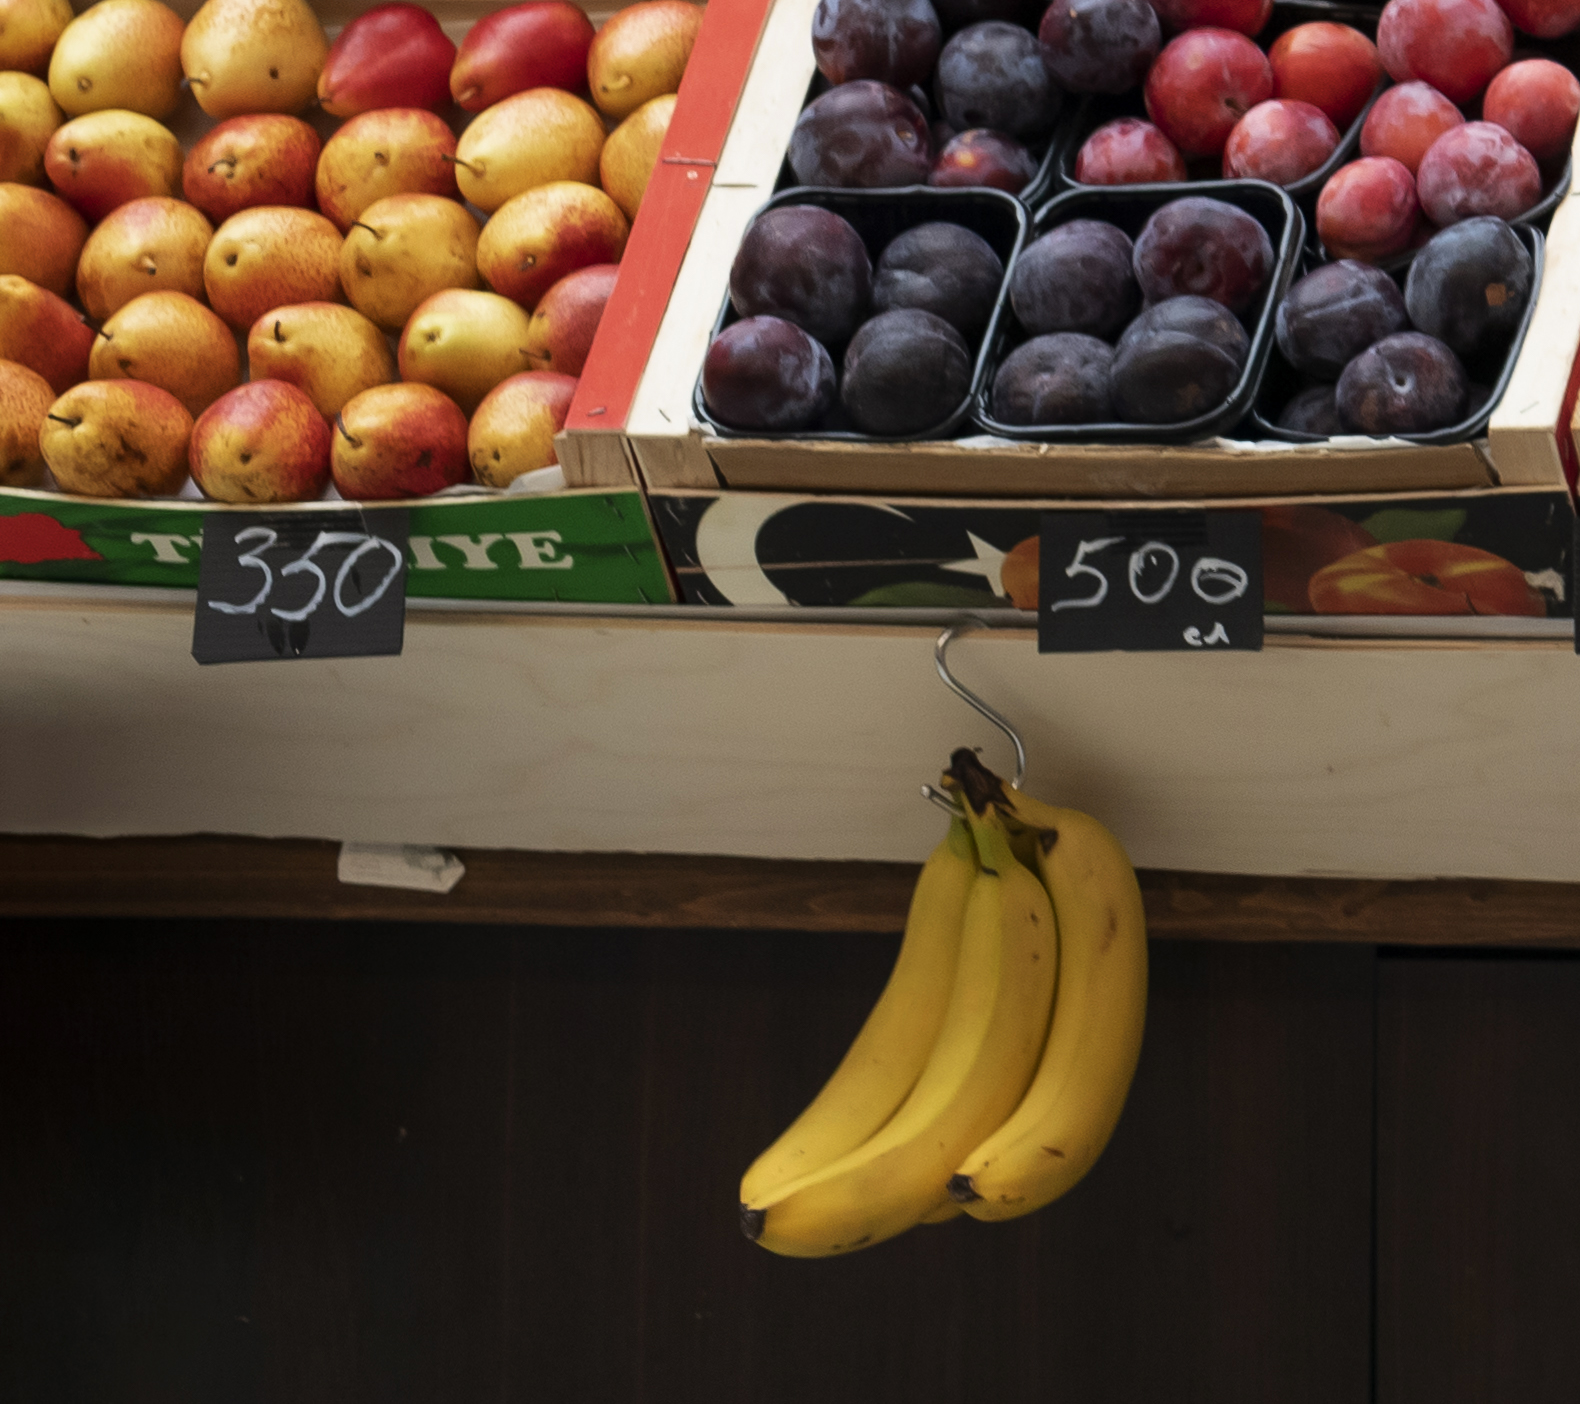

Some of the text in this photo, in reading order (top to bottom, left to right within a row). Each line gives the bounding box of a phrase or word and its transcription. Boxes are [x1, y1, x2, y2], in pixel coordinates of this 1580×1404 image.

[130, 529, 575, 571] TIYE
[207, 526, 403, 622] 350
[1051, 536, 1248, 613] 500
